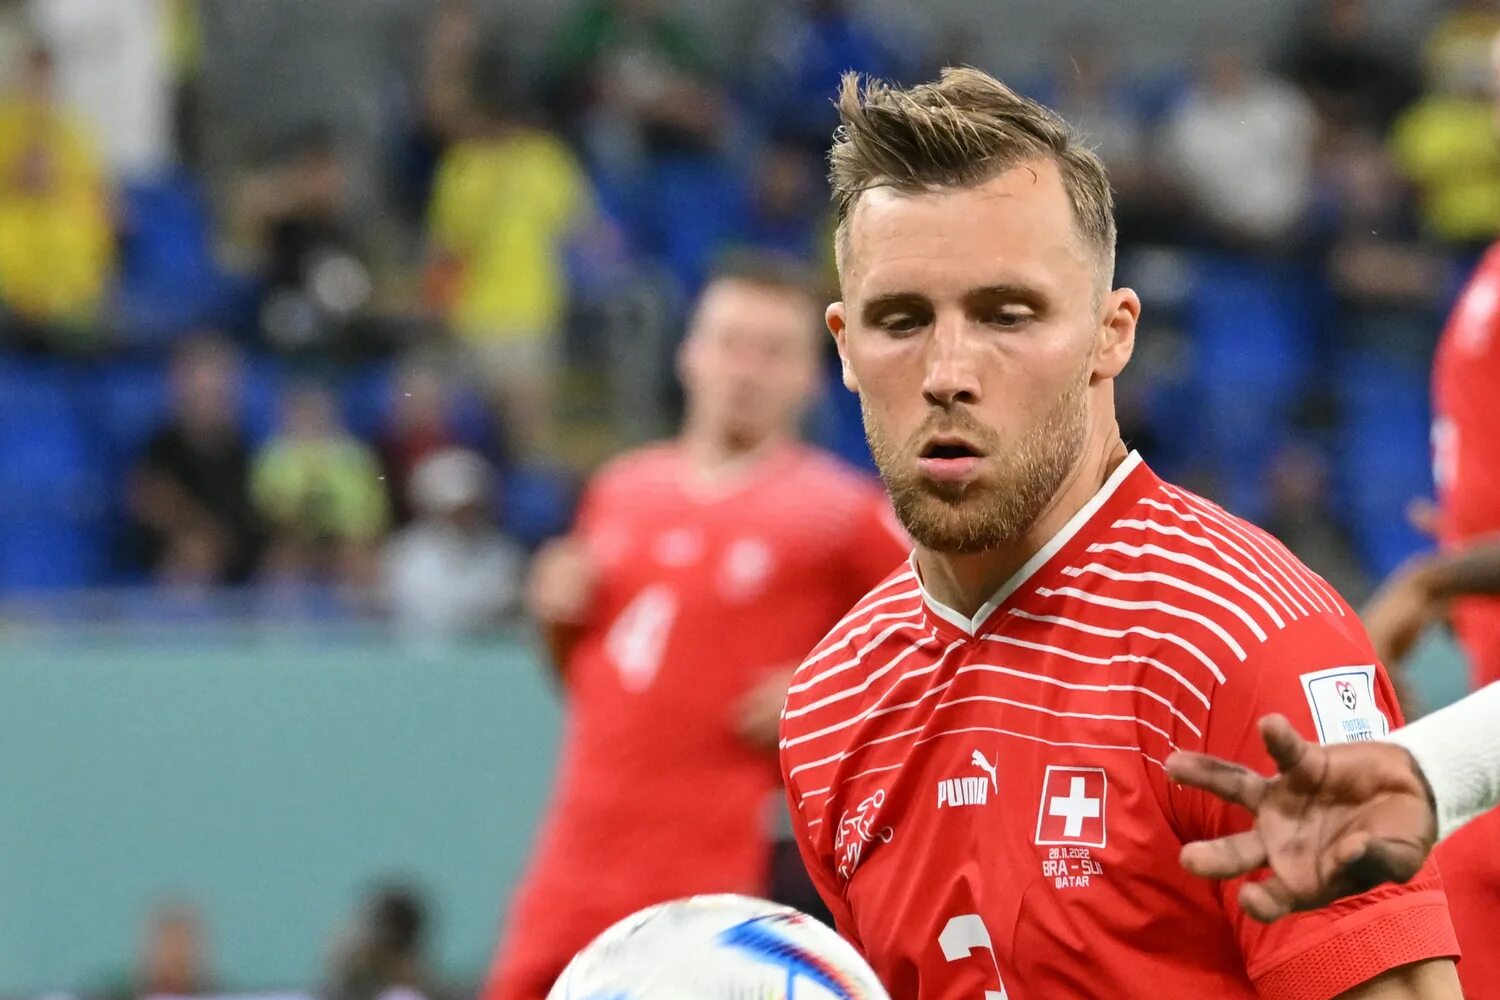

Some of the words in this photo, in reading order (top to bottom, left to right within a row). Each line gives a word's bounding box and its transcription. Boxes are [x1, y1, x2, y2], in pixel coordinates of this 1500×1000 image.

[937, 776, 989, 809] PUMA
[1049, 848, 1090, 859] 28.11.2022
[1042, 860, 1069, 877] BRA
[1055, 875, 1090, 889] QATAR
